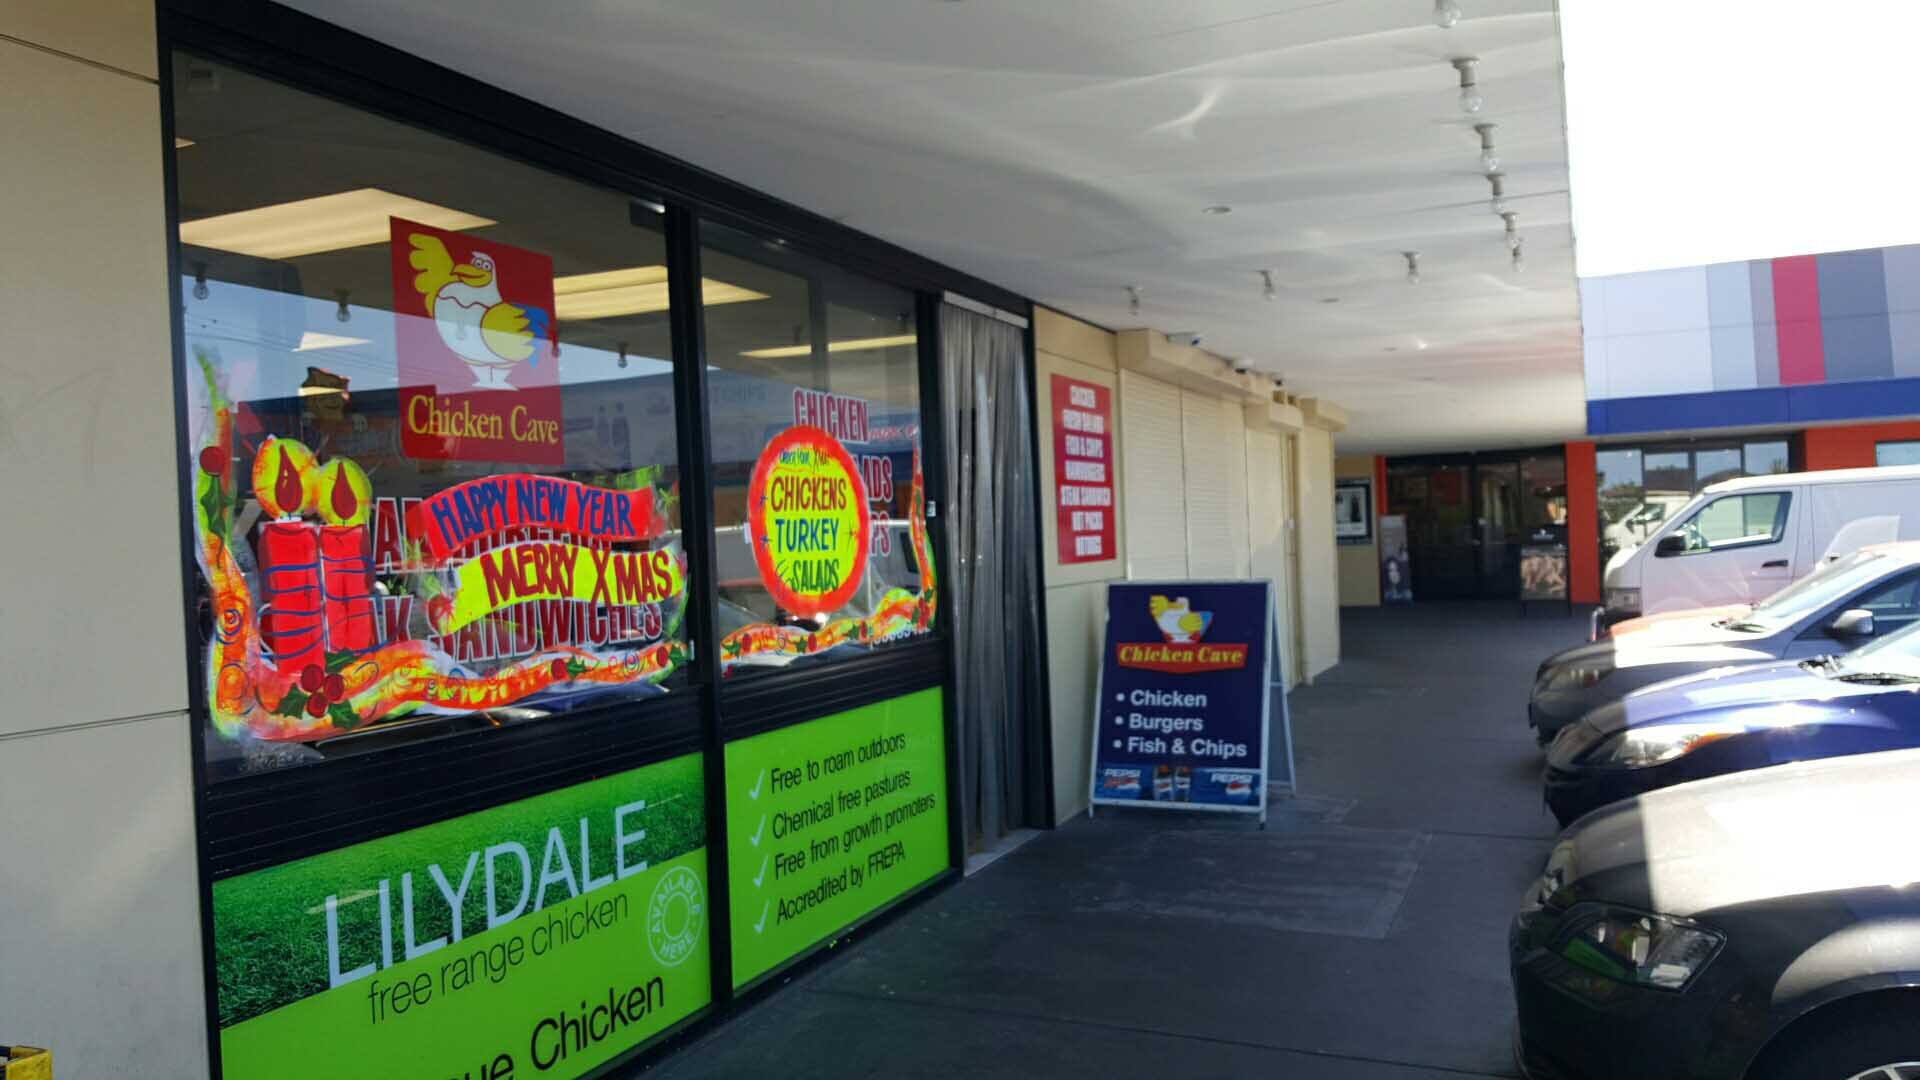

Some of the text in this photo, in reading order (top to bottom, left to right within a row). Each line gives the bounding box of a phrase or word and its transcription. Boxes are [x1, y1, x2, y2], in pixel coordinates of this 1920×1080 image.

[408, 395, 560, 444] Chicken Cave
[793, 387, 870, 445] CHICKEN
[430, 479, 508, 549] HAPPY
[515, 479, 568, 524] NEW
[575, 486, 635, 537] YEAR
[771, 475, 847, 512] CHICKENS
[775, 518, 840, 553] TURKEY
[479, 543, 673, 608] MERRY XMAS
[792, 557, 841, 593] SALADS
[1119, 646, 1244, 664] Chicken Cave
[1129, 713, 1204, 733] Burgers
[1130, 689, 1208, 707] Chicken
[770, 733, 906, 794] Free to roam outdoors
[1104, 768, 1142, 778] PEPSI
[1127, 736, 1248, 760] Fish & Chips
[1210, 772, 1253, 784] PEPSI
[772, 770, 911, 840] Chemical free pastures
[774, 793, 936, 881] Free from growth promoters
[325, 799, 648, 990] LILYDALE
[776, 840, 906, 926] Accredited by FREPA
[367, 893, 629, 1025] free range chicken
[530, 975, 665, 1072] Chicken
